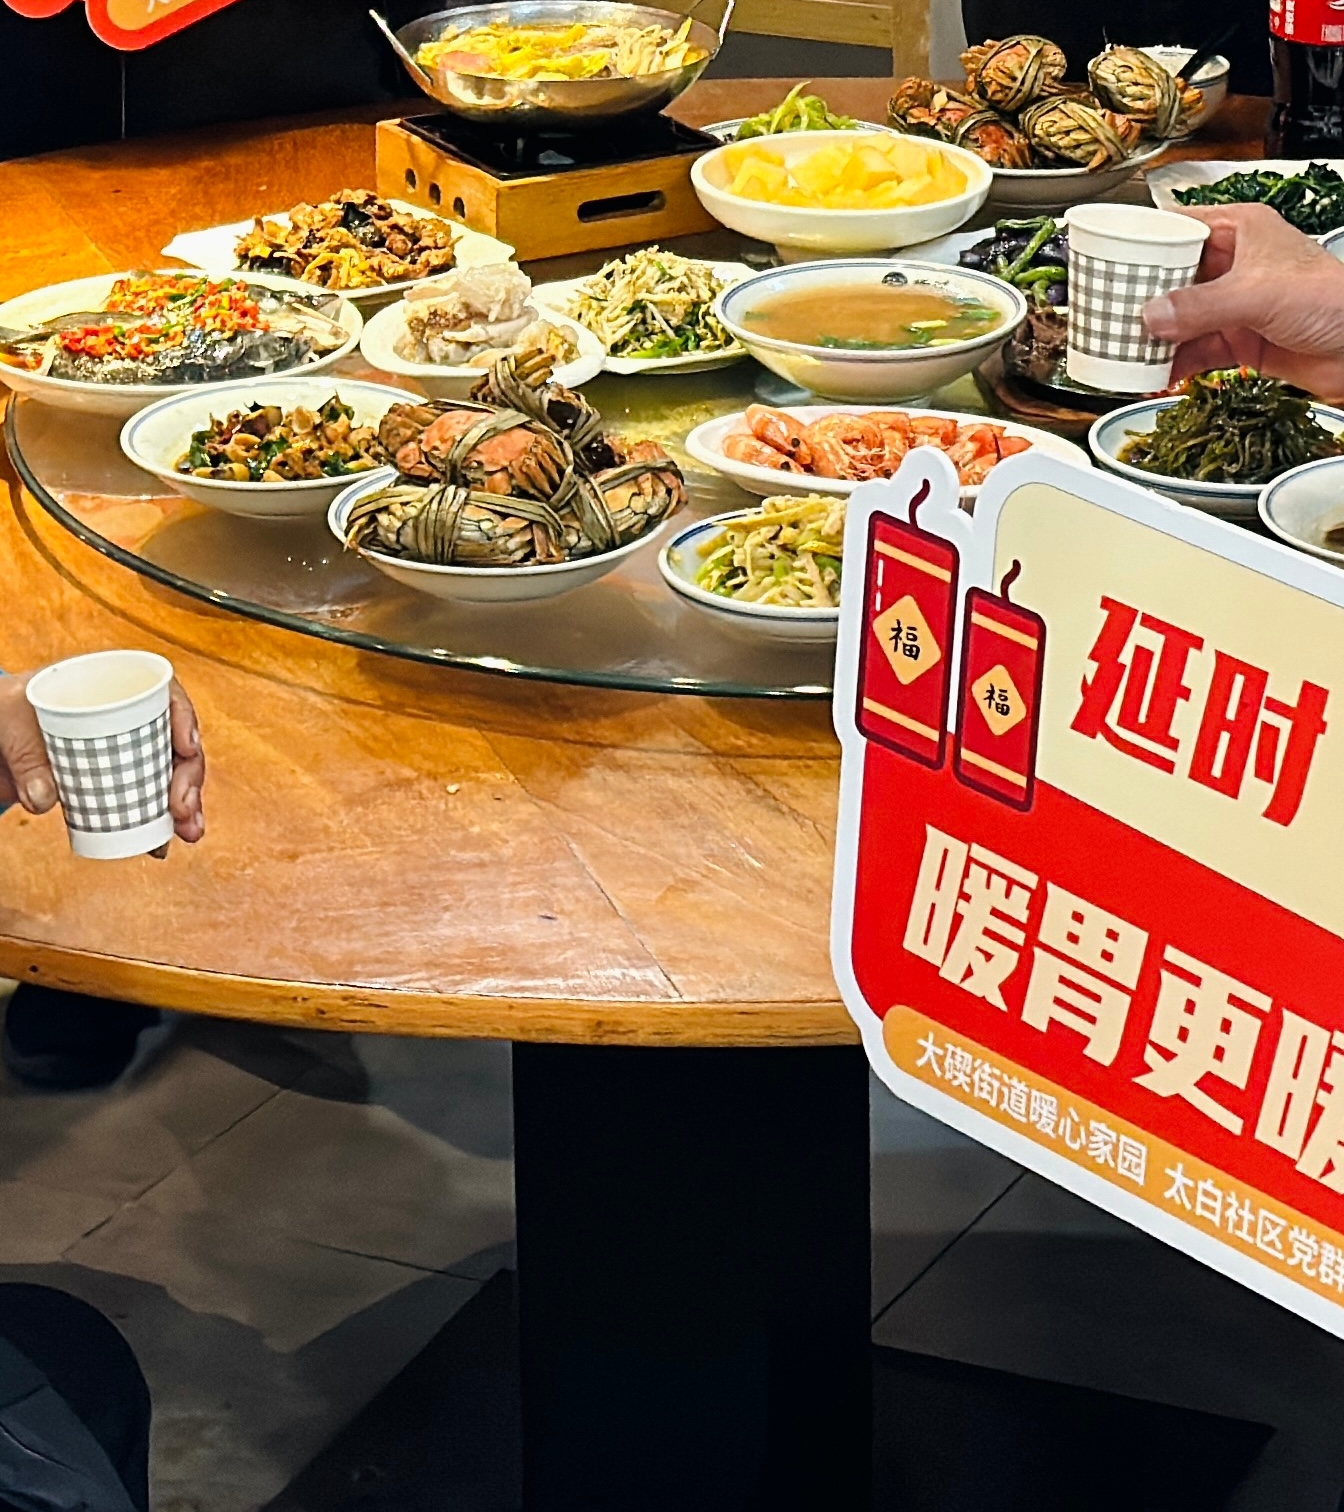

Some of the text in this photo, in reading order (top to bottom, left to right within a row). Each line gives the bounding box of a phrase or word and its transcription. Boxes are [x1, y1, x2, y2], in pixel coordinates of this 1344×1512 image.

[888, 618, 922, 662] 福
[982, 682, 1011, 718] 福
[915, 1031, 1147, 1187] 大碶街道暖心家园
